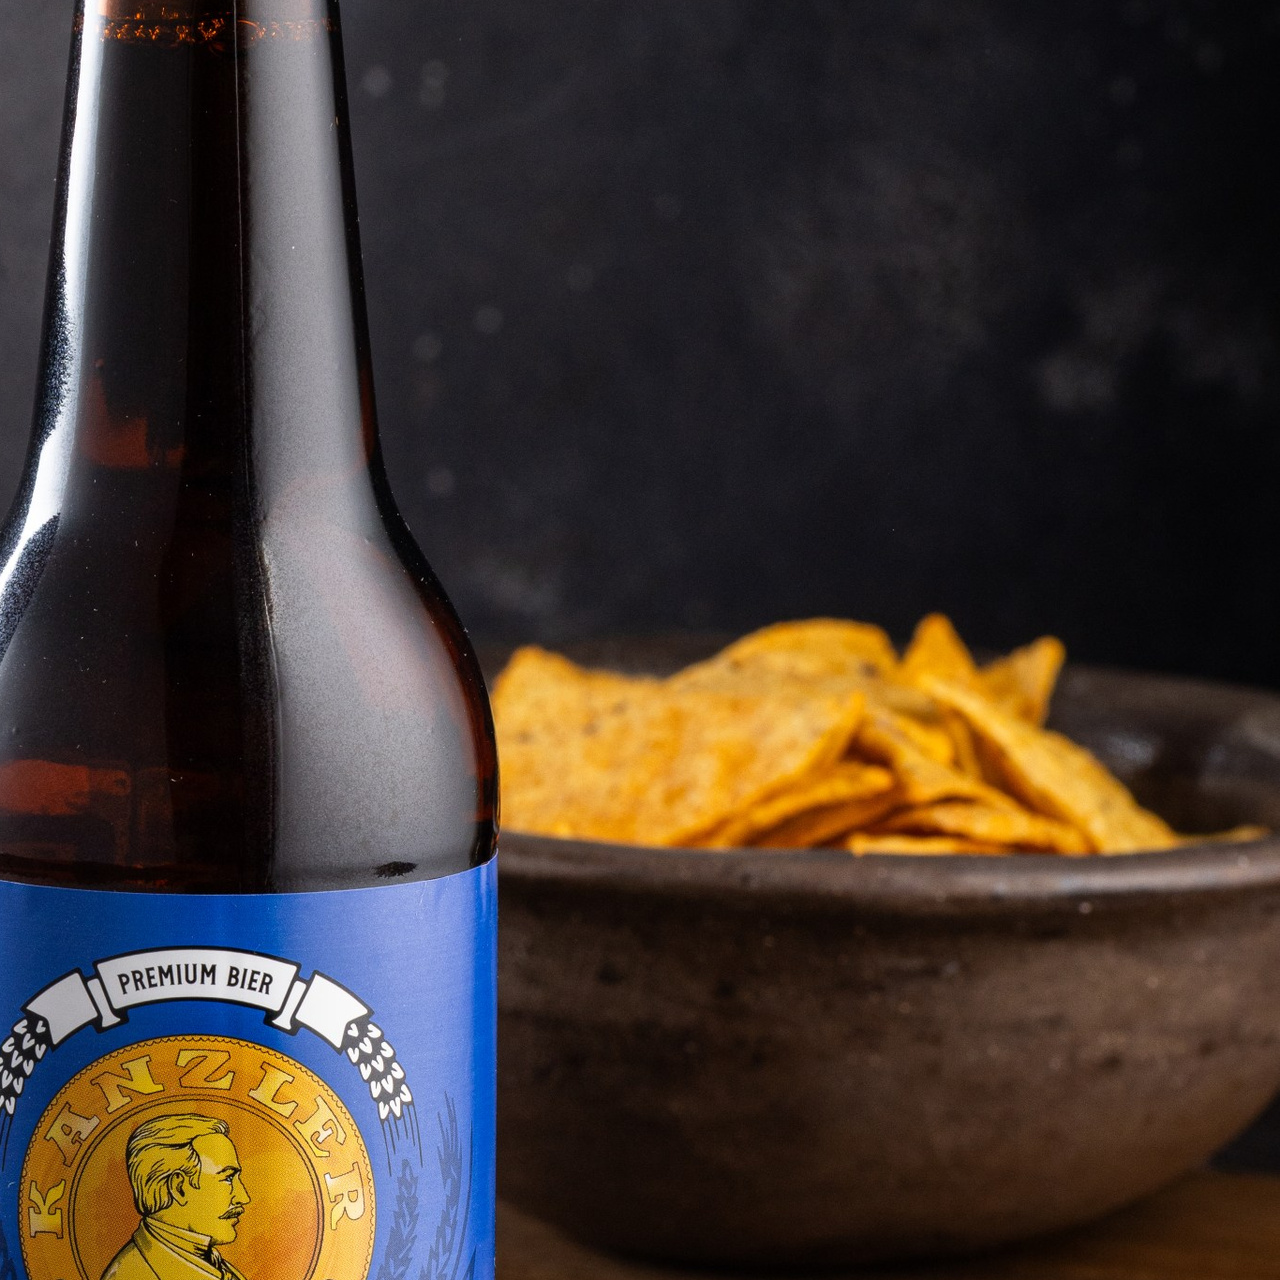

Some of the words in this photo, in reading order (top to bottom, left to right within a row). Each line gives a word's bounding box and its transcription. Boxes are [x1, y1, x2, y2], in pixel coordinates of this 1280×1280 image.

[117, 963, 217, 995] PREMIUM
[226, 965, 274, 995] BIER
[29, 1048, 365, 1239] KANZLER
